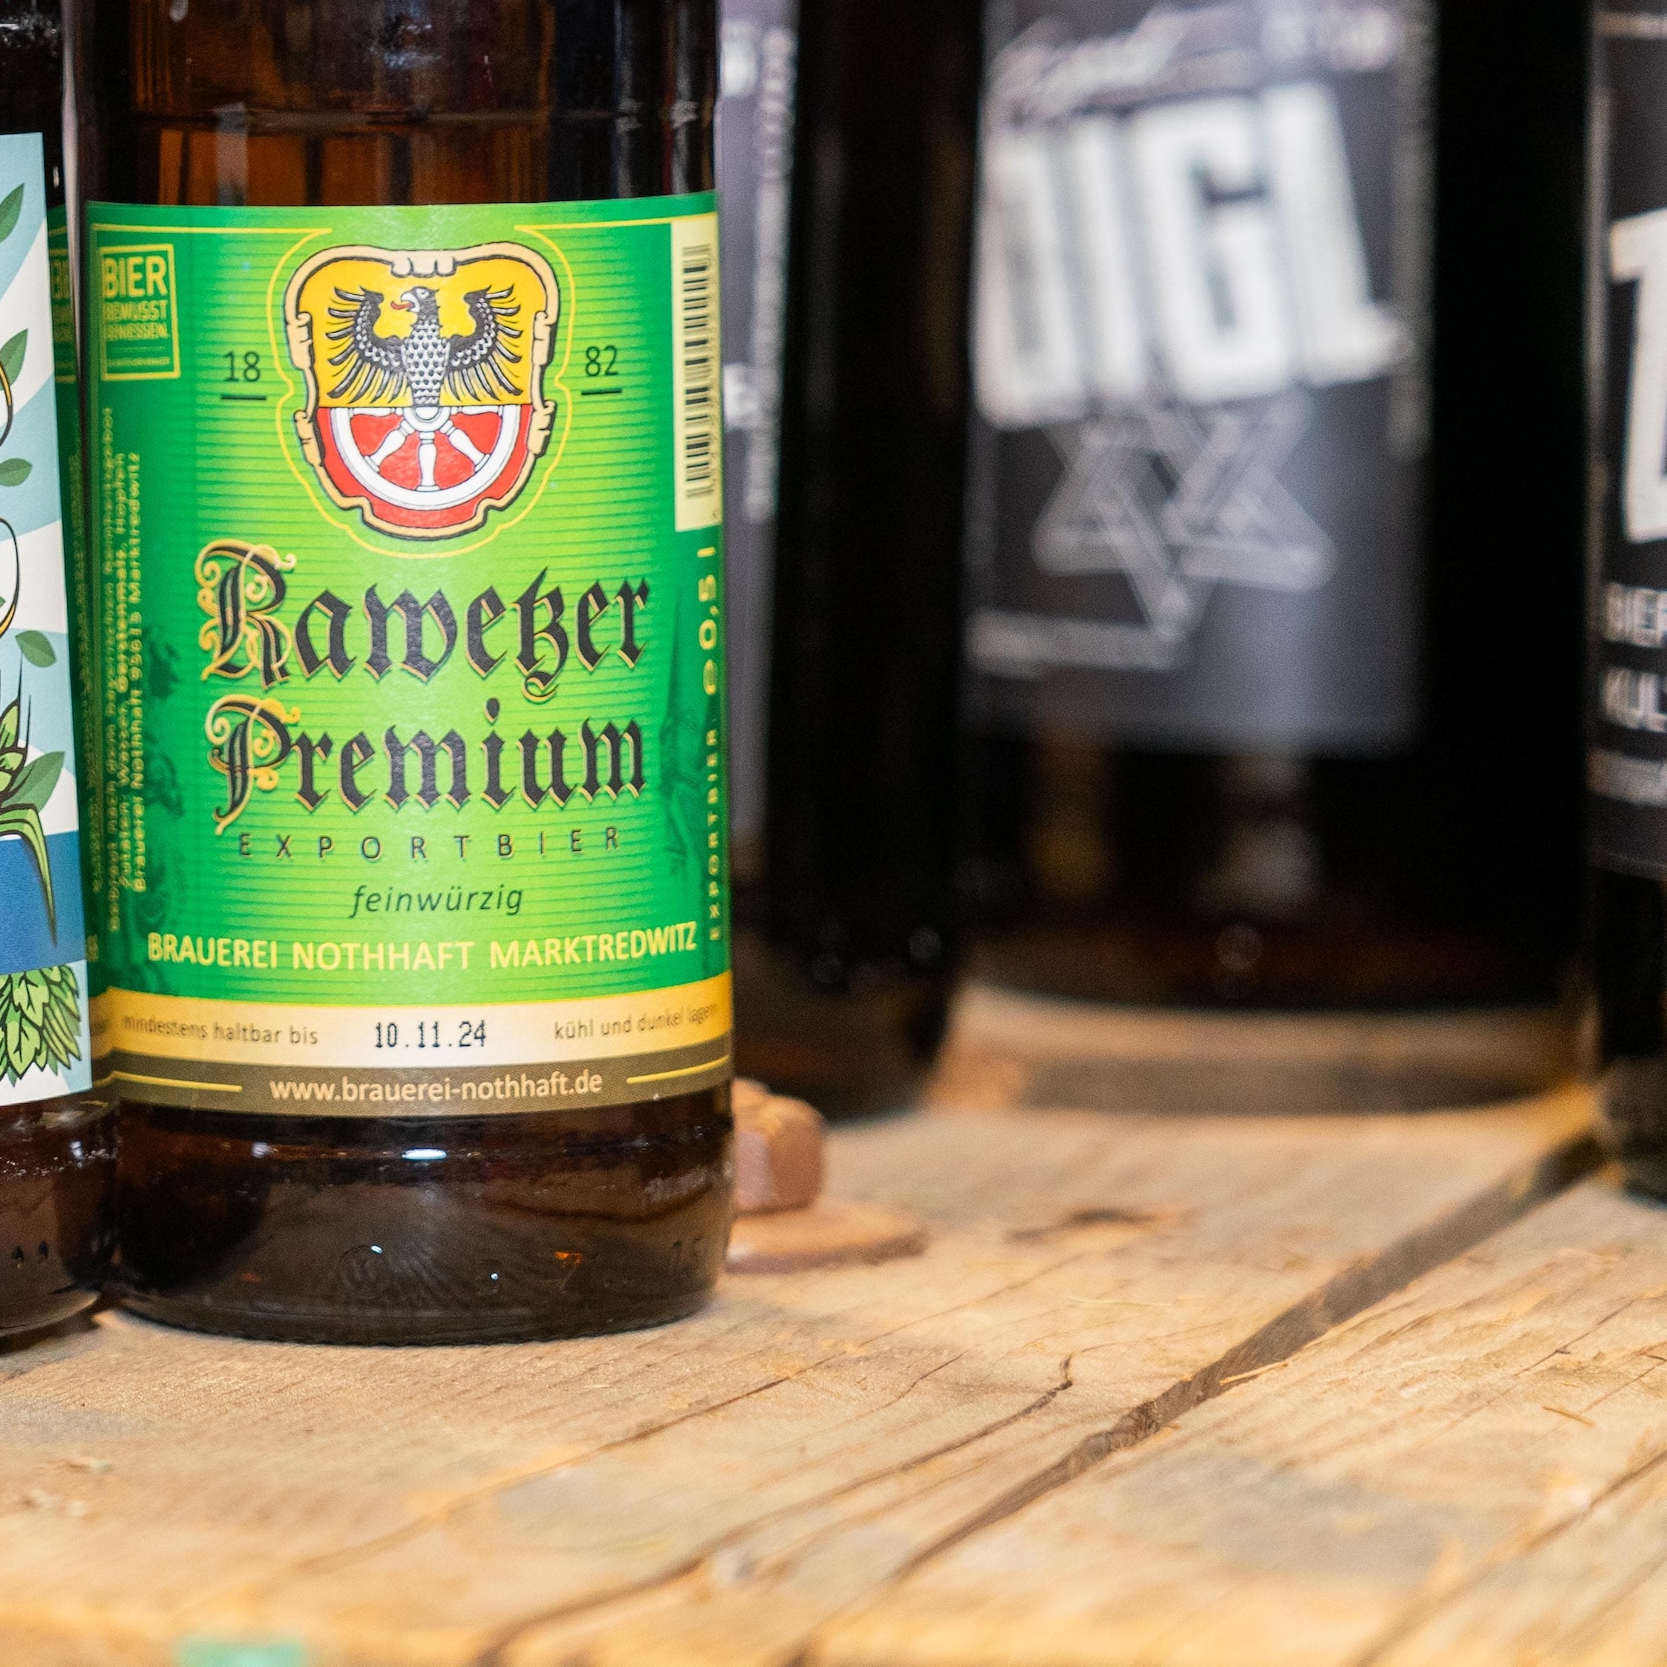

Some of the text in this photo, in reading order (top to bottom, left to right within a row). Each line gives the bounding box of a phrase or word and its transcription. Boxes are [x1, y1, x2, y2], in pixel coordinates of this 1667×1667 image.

[103, 255, 169, 298] BIER
[222, 350, 262, 384] 18
[584, 345, 620, 378] 82
[127, 451, 142, 604] Marktredwitz
[697, 574, 720, 651] 0,5
[129, 687, 145, 789] Nothhaft
[205, 695, 648, 836] Premium
[131, 796, 147, 893] Brauerei
[239, 827, 620, 861] EXPORTBIER
[704, 728, 721, 942] EXPORTBIER
[349, 884, 524, 919] feinwürzig
[147, 922, 698, 972] BRAUEREI NOTHHAFT MARKTREDWITZ
[213, 1020, 283, 1045] haltbar
[289, 1025, 319, 1046] bis
[374, 1019, 488, 1049] 10.11.24
[554, 1018, 595, 1040] kühl
[599, 1014, 633, 1036] und
[637, 1005, 684, 1031] dunkel
[268, 1070, 604, 1107] www.brauerei-nothhaft.de
